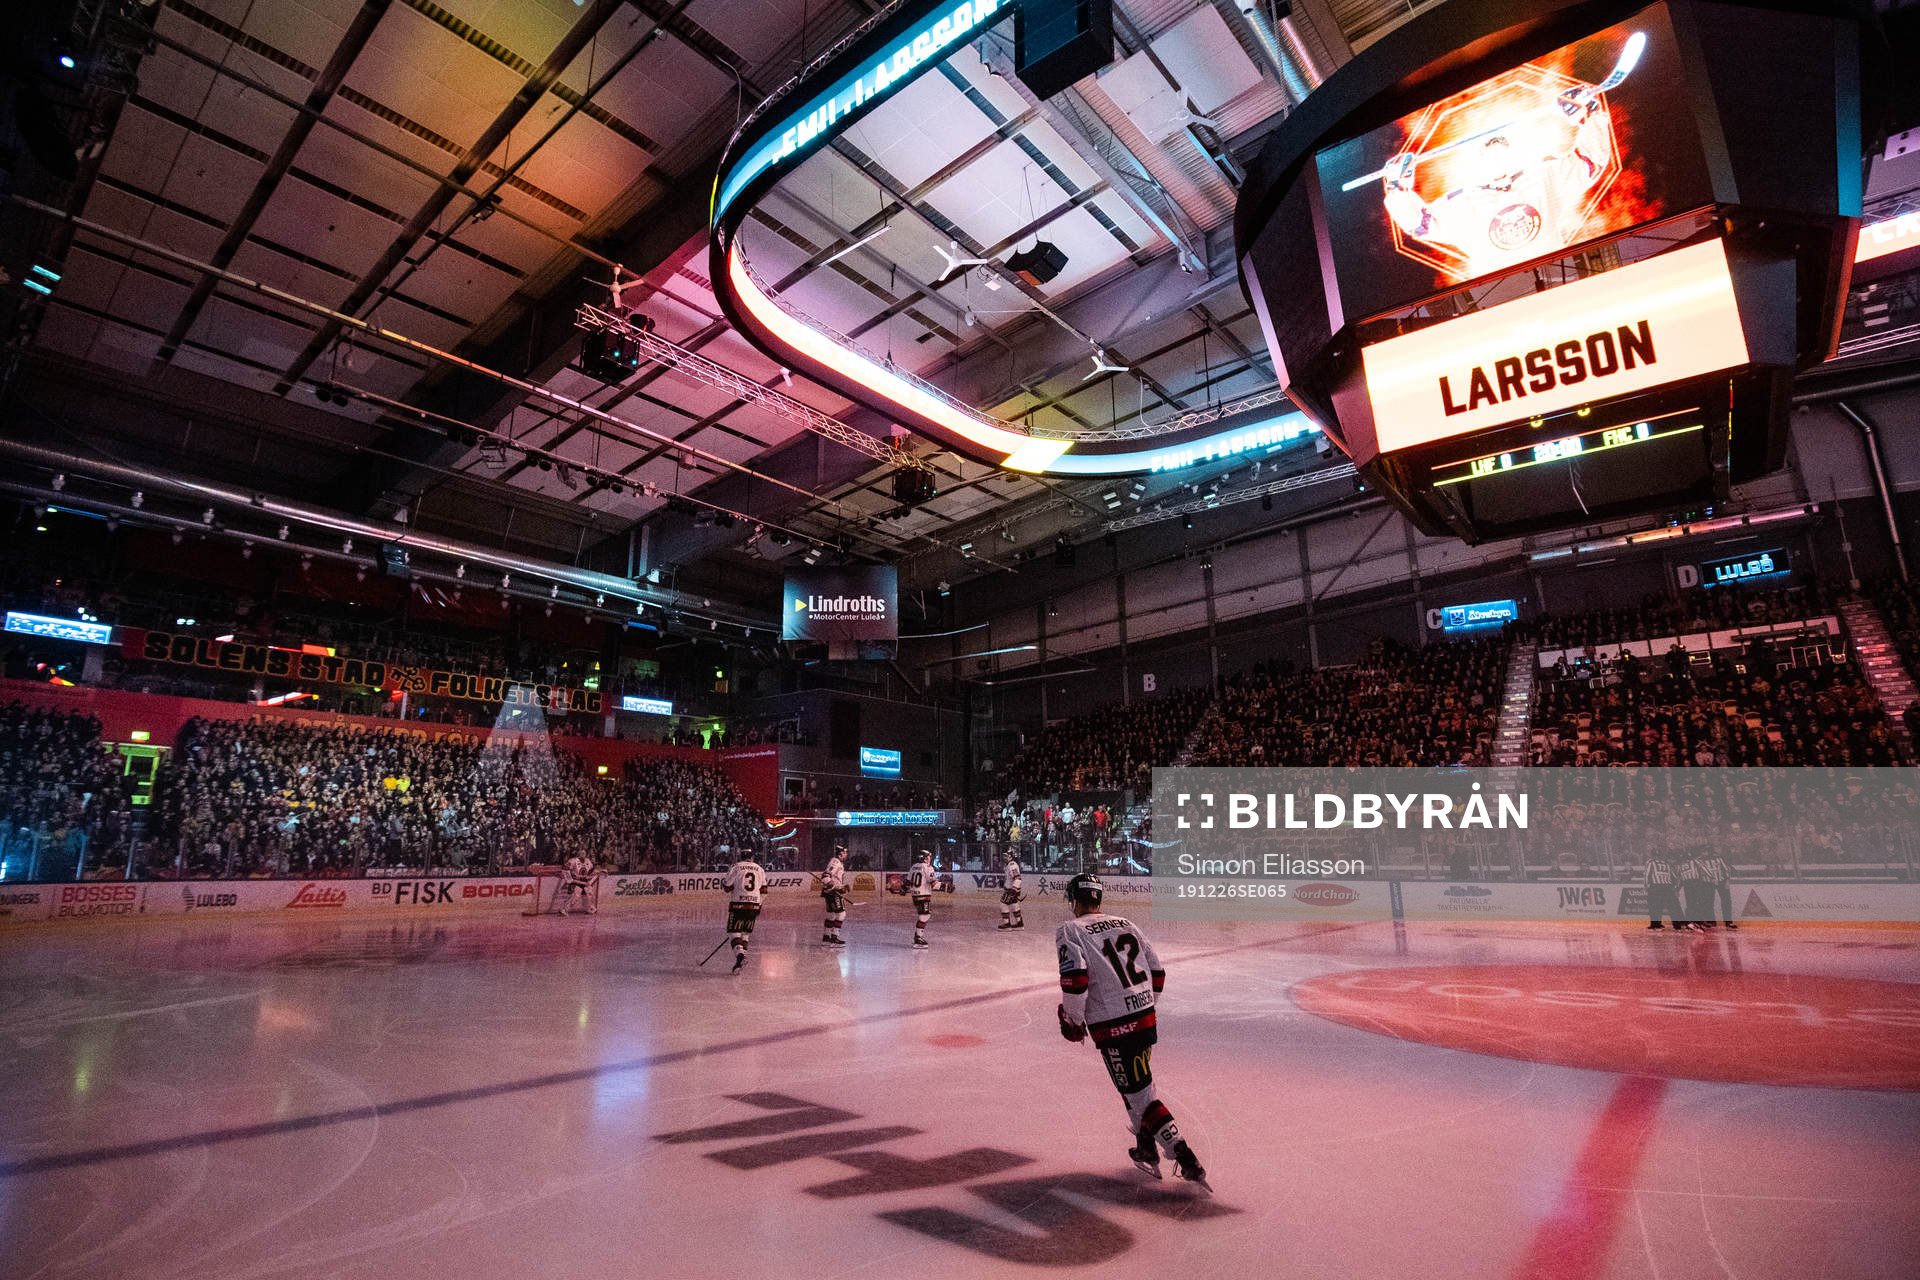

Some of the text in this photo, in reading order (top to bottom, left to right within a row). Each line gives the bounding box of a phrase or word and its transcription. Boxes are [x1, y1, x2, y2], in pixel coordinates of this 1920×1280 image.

[1439, 320, 1657, 416] LARSSON
[1602, 426, 1633, 446] FHC
[1677, 564, 1698, 588] D
[808, 595, 885, 612] Lindroths
[813, 613, 859, 621] MotorCenter
[1426, 608, 1442, 629] C
[145, 631, 601, 714] SOLENS STAD FOLKETS LAG
[1143, 673, 1156, 691] B
[744, 872, 755, 891] 3
[766, 878, 802, 888] UER
[61, 885, 137, 903] BOSSES
[196, 894, 237, 907] LULEBO
[372, 881, 456, 904] BD FISK
[462, 884, 535, 899] BORGA
[1293, 888, 1360, 900] NordChark
[1556, 887, 1606, 908] JWAB
[1101, 933, 1148, 989] 12
[1110, 1021, 1138, 1037] SKF
